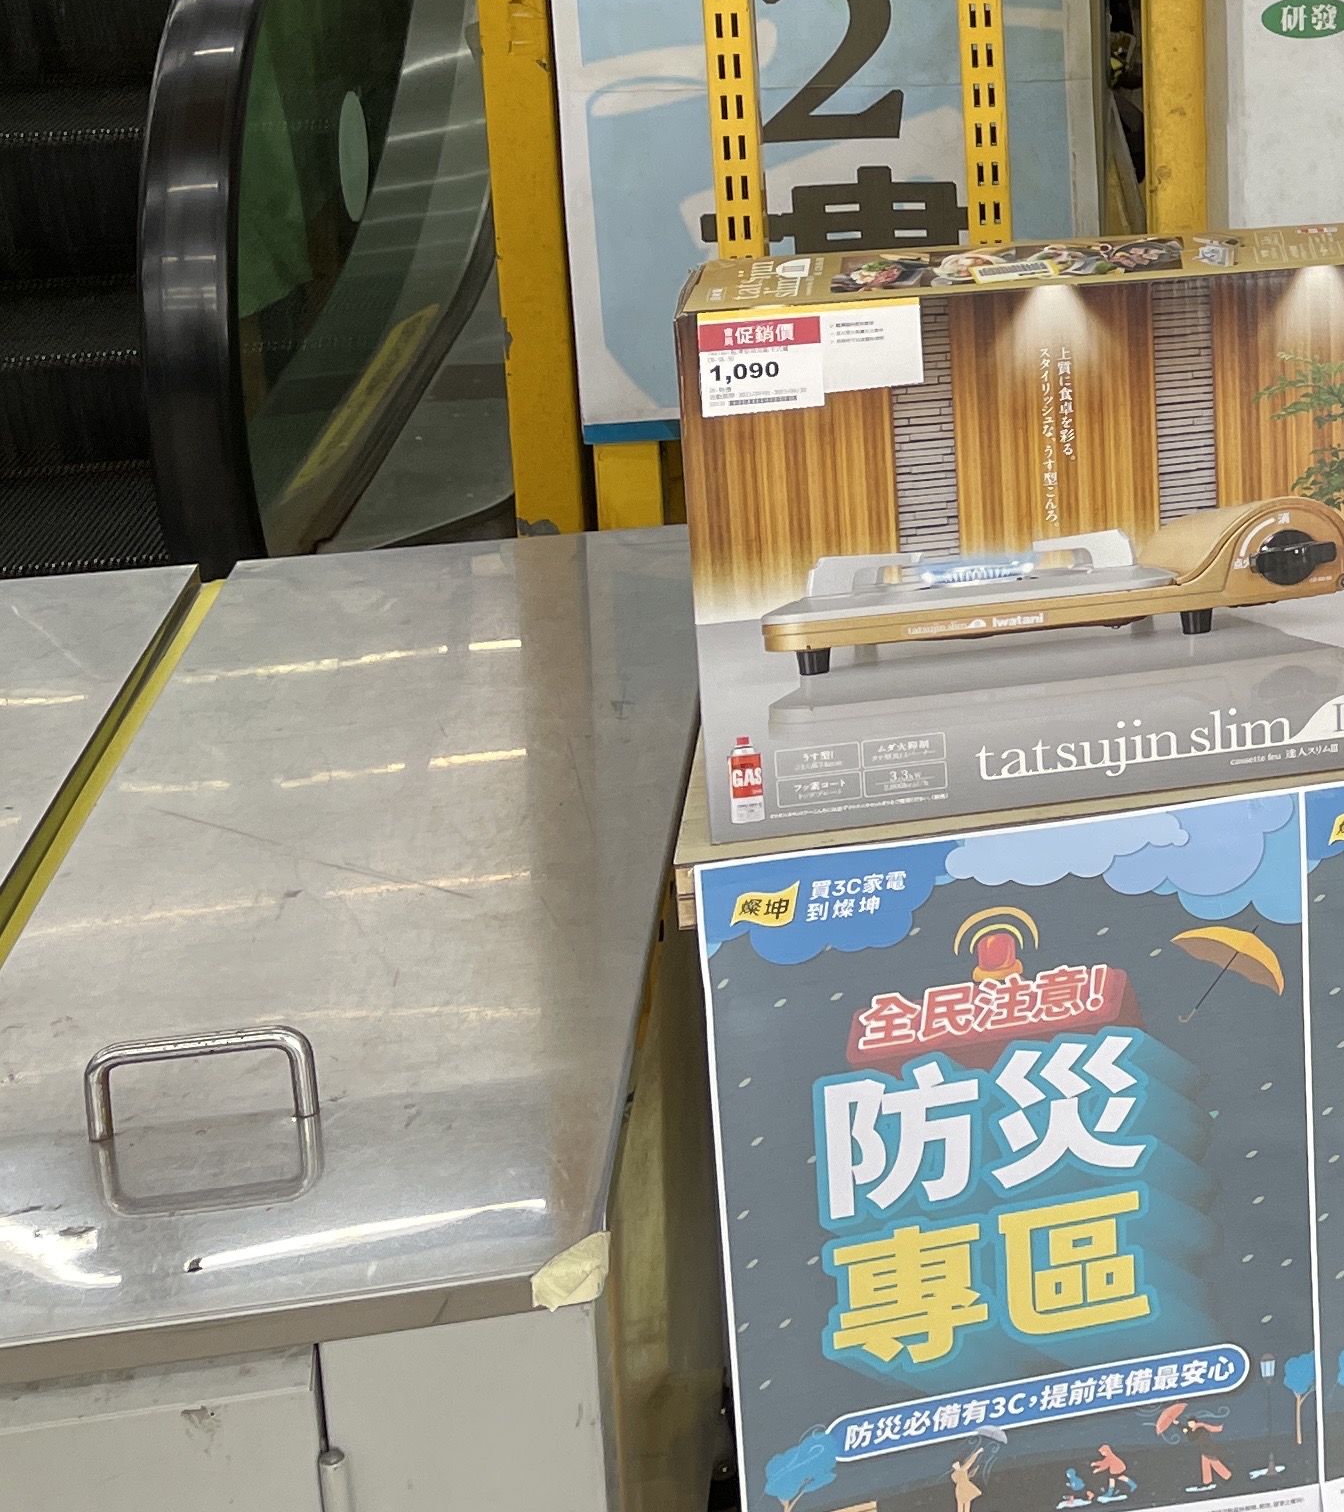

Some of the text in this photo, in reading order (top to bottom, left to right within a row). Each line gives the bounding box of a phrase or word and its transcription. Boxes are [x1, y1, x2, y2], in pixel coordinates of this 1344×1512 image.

[1280, 4, 1338, 33] 研發
[735, 322, 796, 345] 促銷價
[709, 360, 780, 384] 1,090
[975, 717, 1184, 782] tatsujin
[1187, 707, 1292, 762] slim
[731, 767, 763, 789] GAS
[809, 870, 907, 900] 買3C家電
[738, 897, 789, 919] 燦坤
[806, 896, 881, 923] 到燦坤
[858, 965, 1107, 1051] 全民注意!
[824, 1035, 1147, 1219] 防災
[832, 1190, 1151, 1363] 專區
